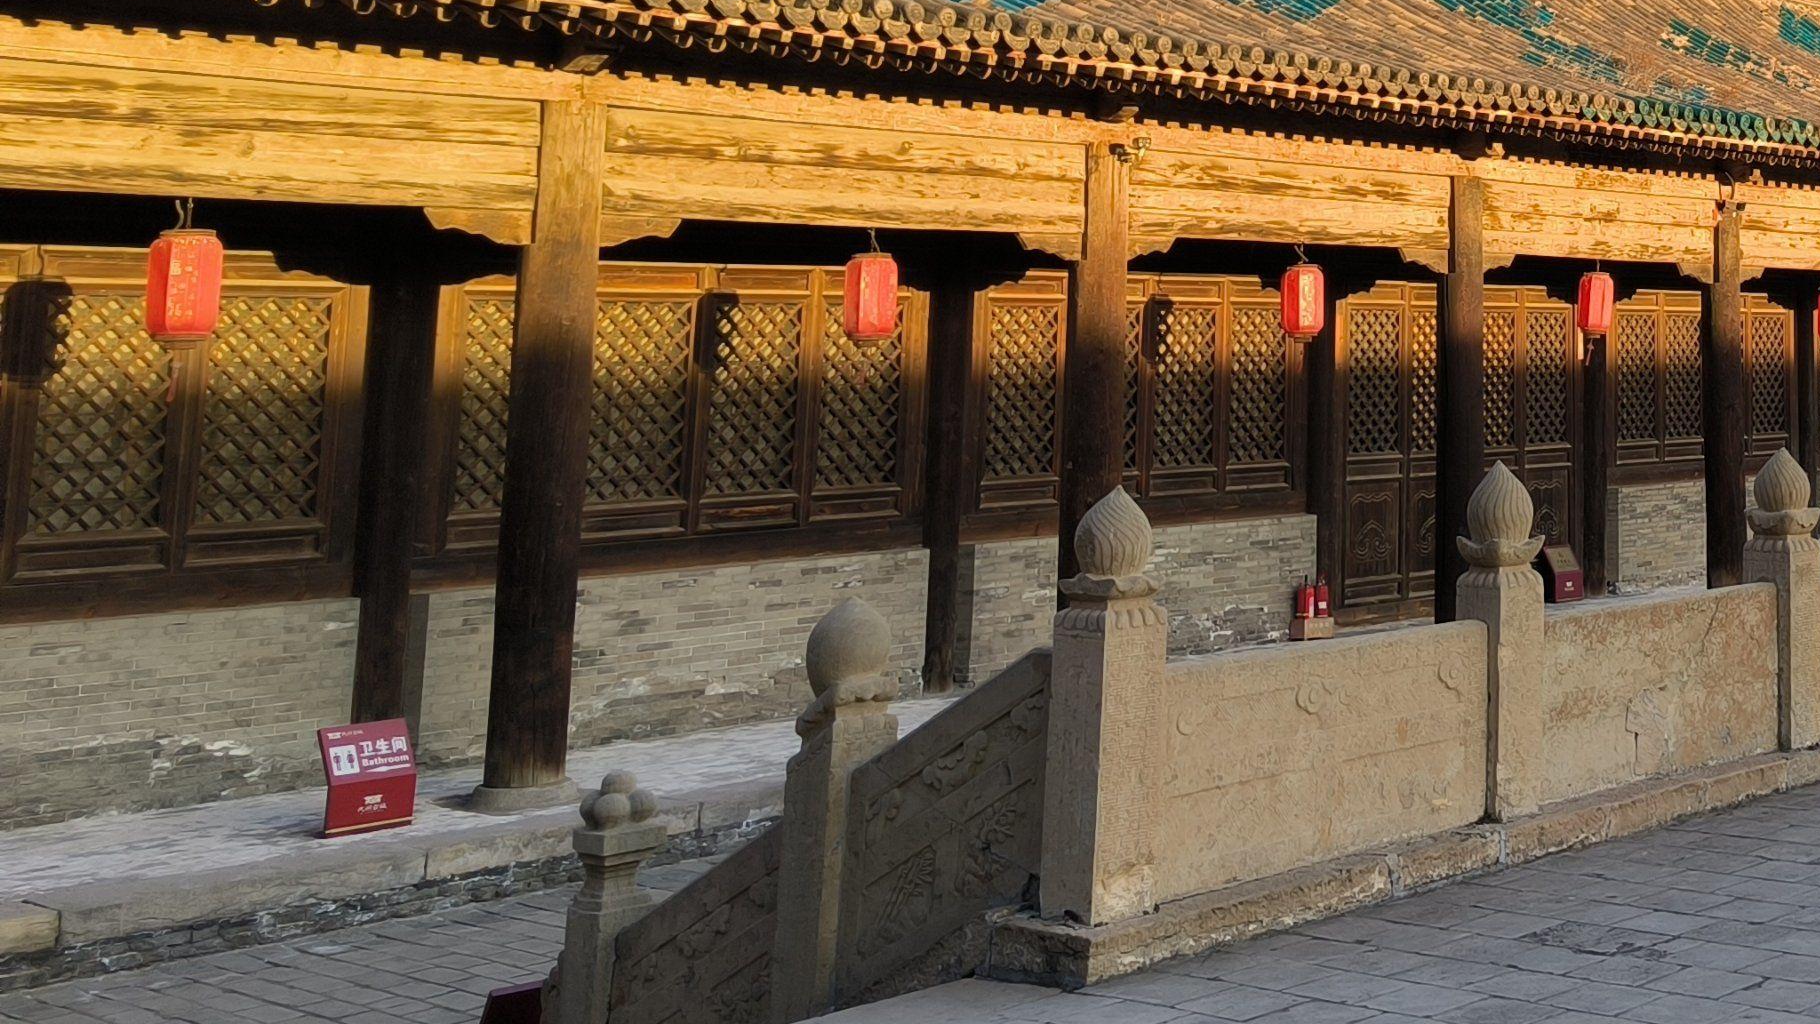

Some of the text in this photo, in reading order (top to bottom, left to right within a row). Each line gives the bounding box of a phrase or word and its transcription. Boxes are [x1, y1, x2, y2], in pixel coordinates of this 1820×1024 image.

[359, 736, 407, 757] 卫生间
[362, 755, 409, 766] Bathroom
